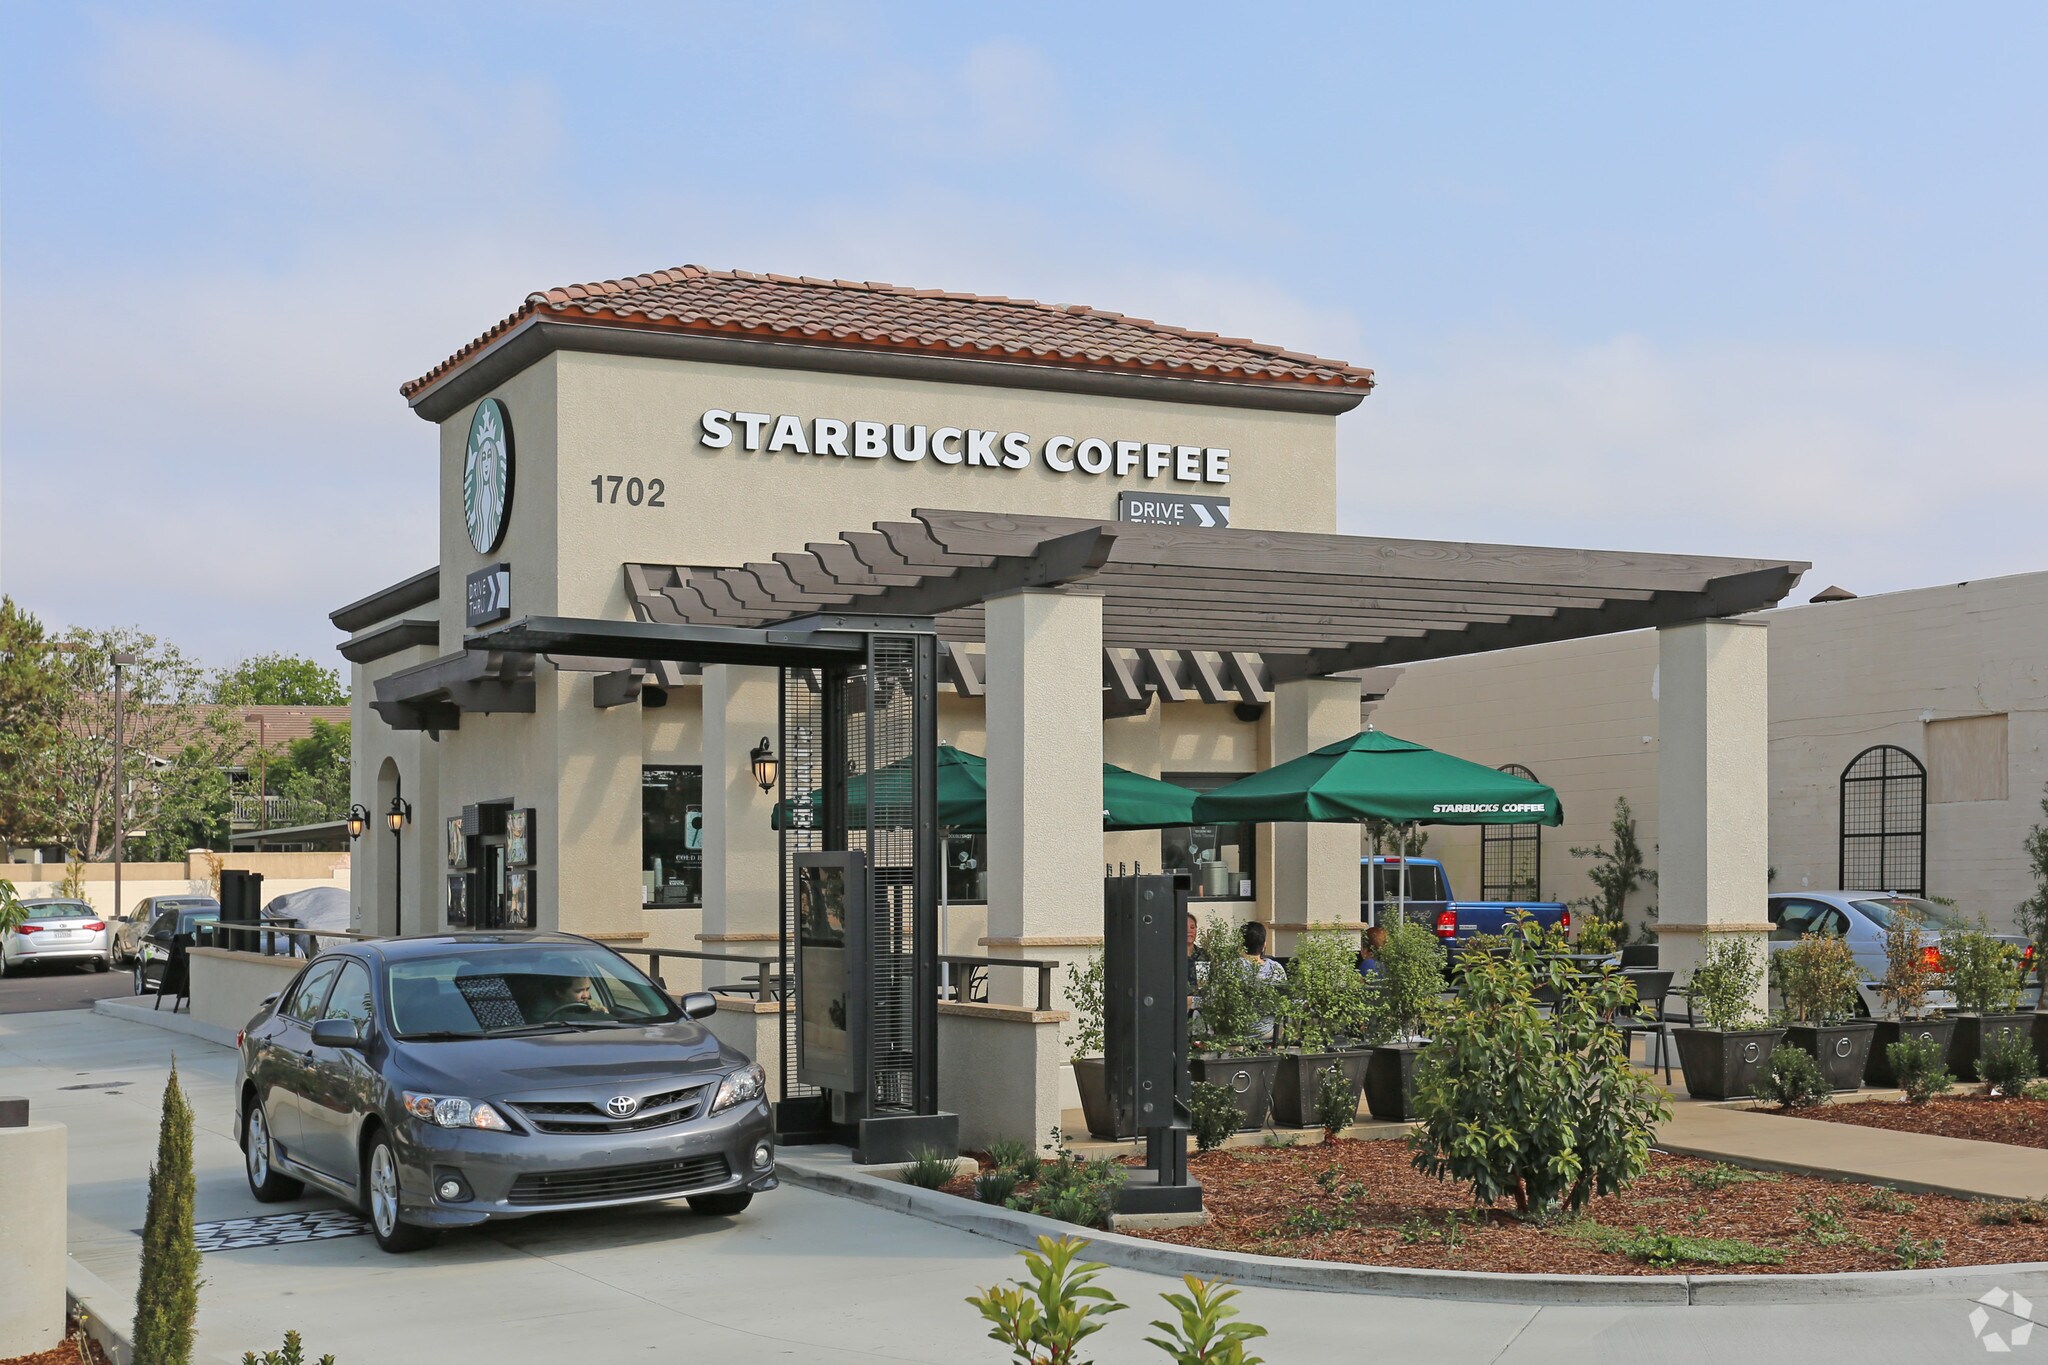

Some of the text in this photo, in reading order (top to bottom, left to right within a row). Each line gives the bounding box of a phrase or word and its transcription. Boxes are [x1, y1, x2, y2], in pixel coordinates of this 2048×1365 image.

[700, 408, 1231, 484] STARBUCKS COFFEE
[591, 474, 665, 507] 1702
[1130, 500, 1185, 519] DRIVE
[469, 579, 486, 599] DRIVE
[469, 598, 485, 617] THRU
[1433, 804, 1545, 813] STARBUCKS COFFEE
